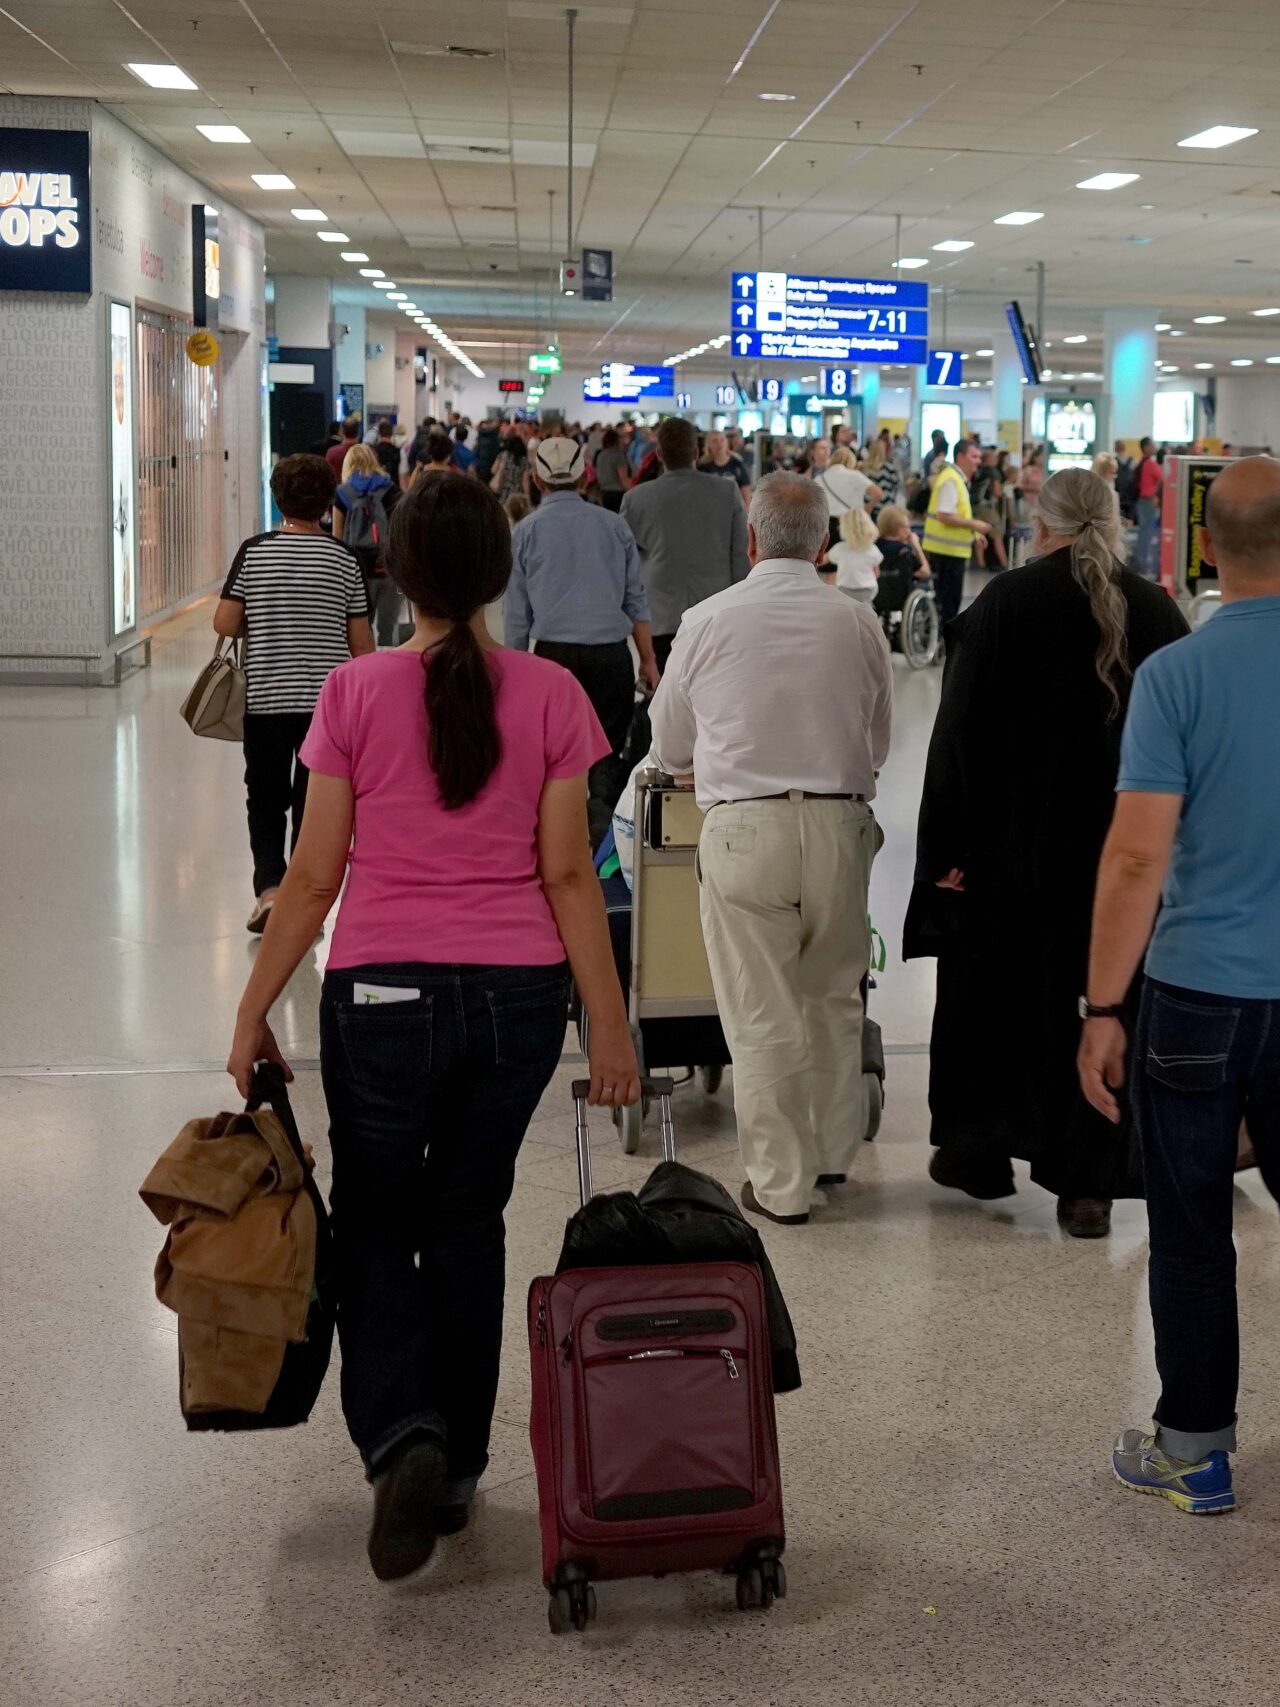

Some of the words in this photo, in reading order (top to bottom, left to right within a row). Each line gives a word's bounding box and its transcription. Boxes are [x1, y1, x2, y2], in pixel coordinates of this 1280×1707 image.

[1, 115, 88, 130] COSMETICS
[0, 172, 78, 207] AVEL
[0, 207, 79, 248] OPS
[867, 309, 907, 333] 7-11
[2, 328, 85, 344] LIQUORS
[6, 358, 91, 373] COSMETICS
[934, 351, 953, 385] 7
[766, 379, 779, 400] 9
[831, 369, 846, 395] 8
[677, 393, 691, 409] 11
[716, 386, 735, 404] 10
[1190, 483, 1206, 524] Trolley
